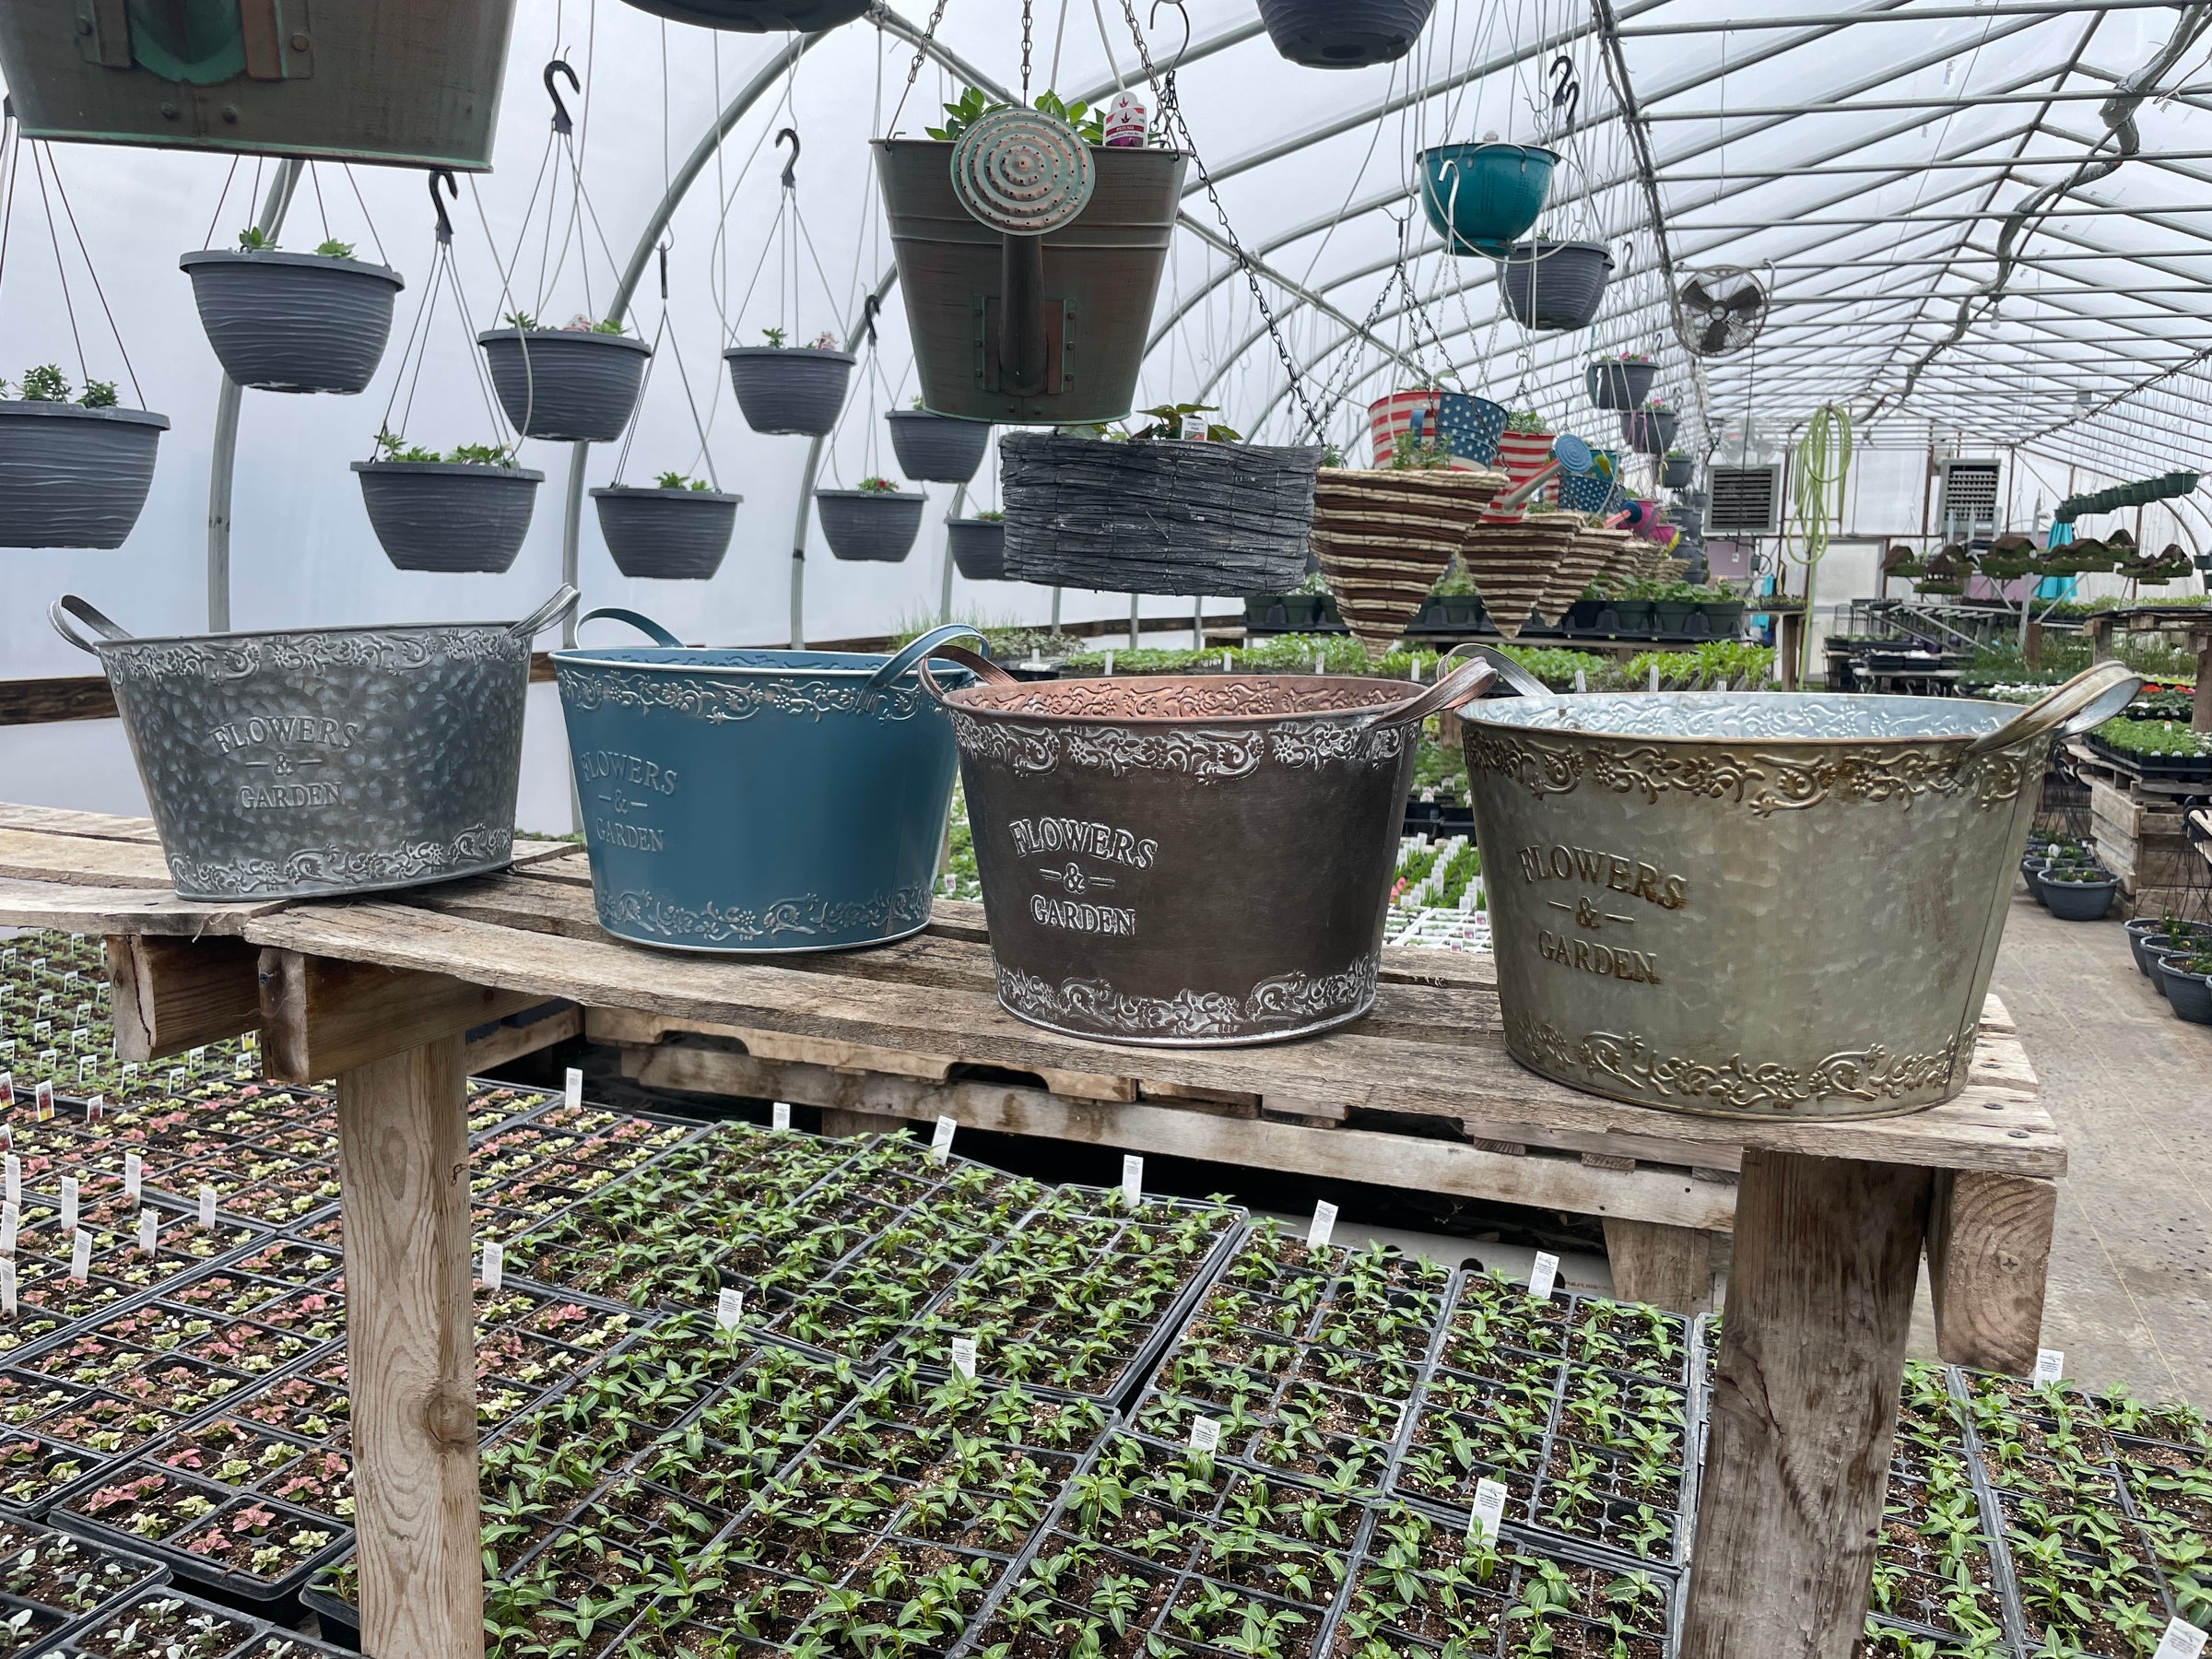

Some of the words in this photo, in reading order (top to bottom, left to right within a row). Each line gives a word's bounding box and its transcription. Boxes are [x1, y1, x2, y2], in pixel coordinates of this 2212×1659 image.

[208, 715, 359, 756] FLOWERS
[580, 750, 678, 795] FLOWERS
[237, 782, 345, 809] GARDEN
[596, 818, 665, 853] GARDEN
[1008, 817, 1159, 871] FLOWERS
[1516, 844, 1688, 910] FLOWERS
[1030, 894, 1136, 936] GARDEN
[1537, 929, 1662, 985] GARDEN
